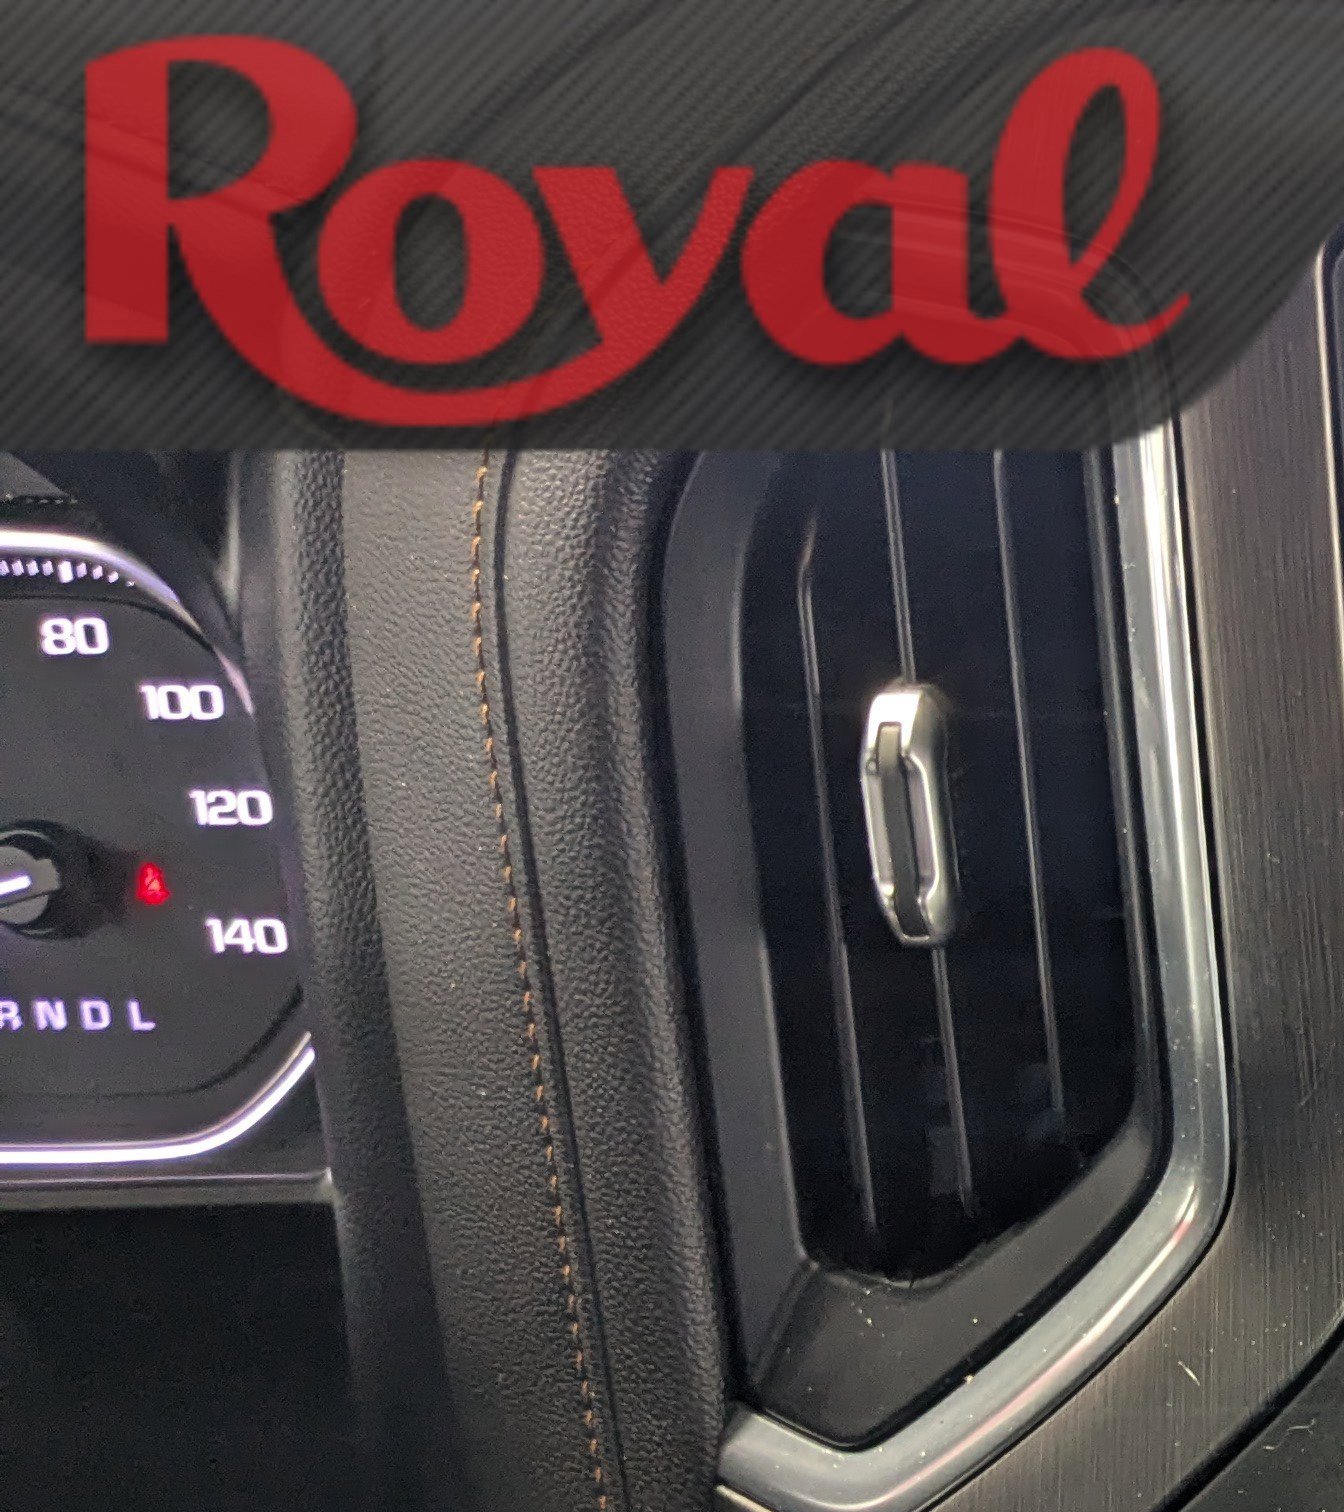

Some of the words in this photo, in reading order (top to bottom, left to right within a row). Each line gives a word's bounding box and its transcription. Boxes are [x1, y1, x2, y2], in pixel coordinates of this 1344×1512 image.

[39, 616, 110, 656] 80
[138, 683, 225, 721] 100
[188, 788, 274, 827] 120
[204, 917, 289, 955] 140
